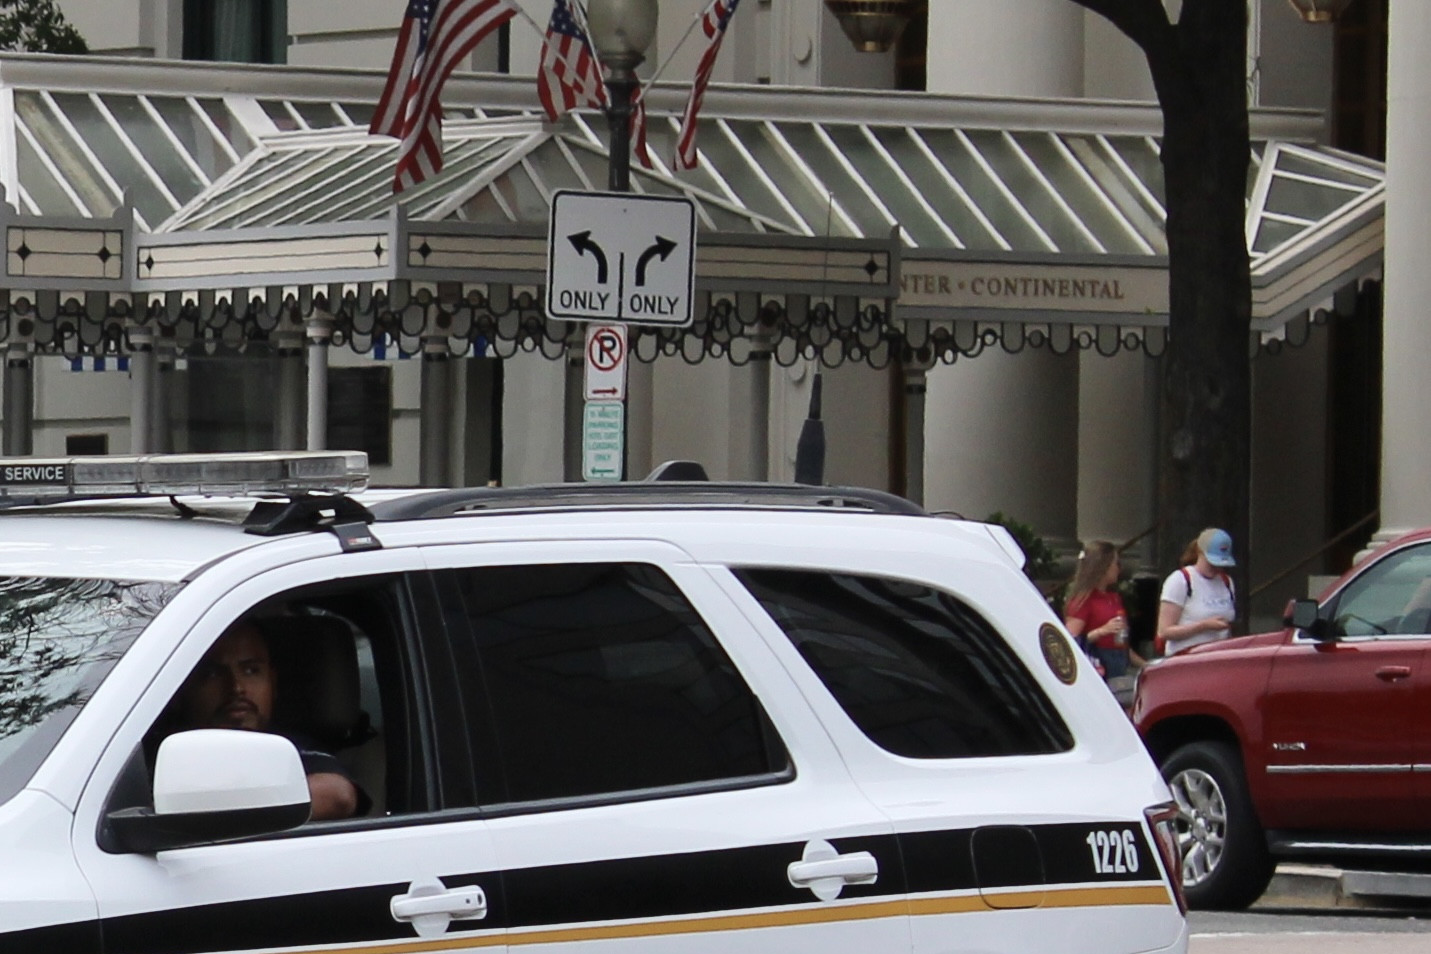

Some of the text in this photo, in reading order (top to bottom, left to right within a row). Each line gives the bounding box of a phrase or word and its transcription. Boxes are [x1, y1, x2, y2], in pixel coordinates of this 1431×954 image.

[898, 274, 1125, 300] NTER CONTINENTAL
[560, 290, 610, 311] ONLY
[630, 293, 679, 315] ONLY
[5, 466, 64, 481] SERVICE
[1086, 829, 1139, 873] 1226
